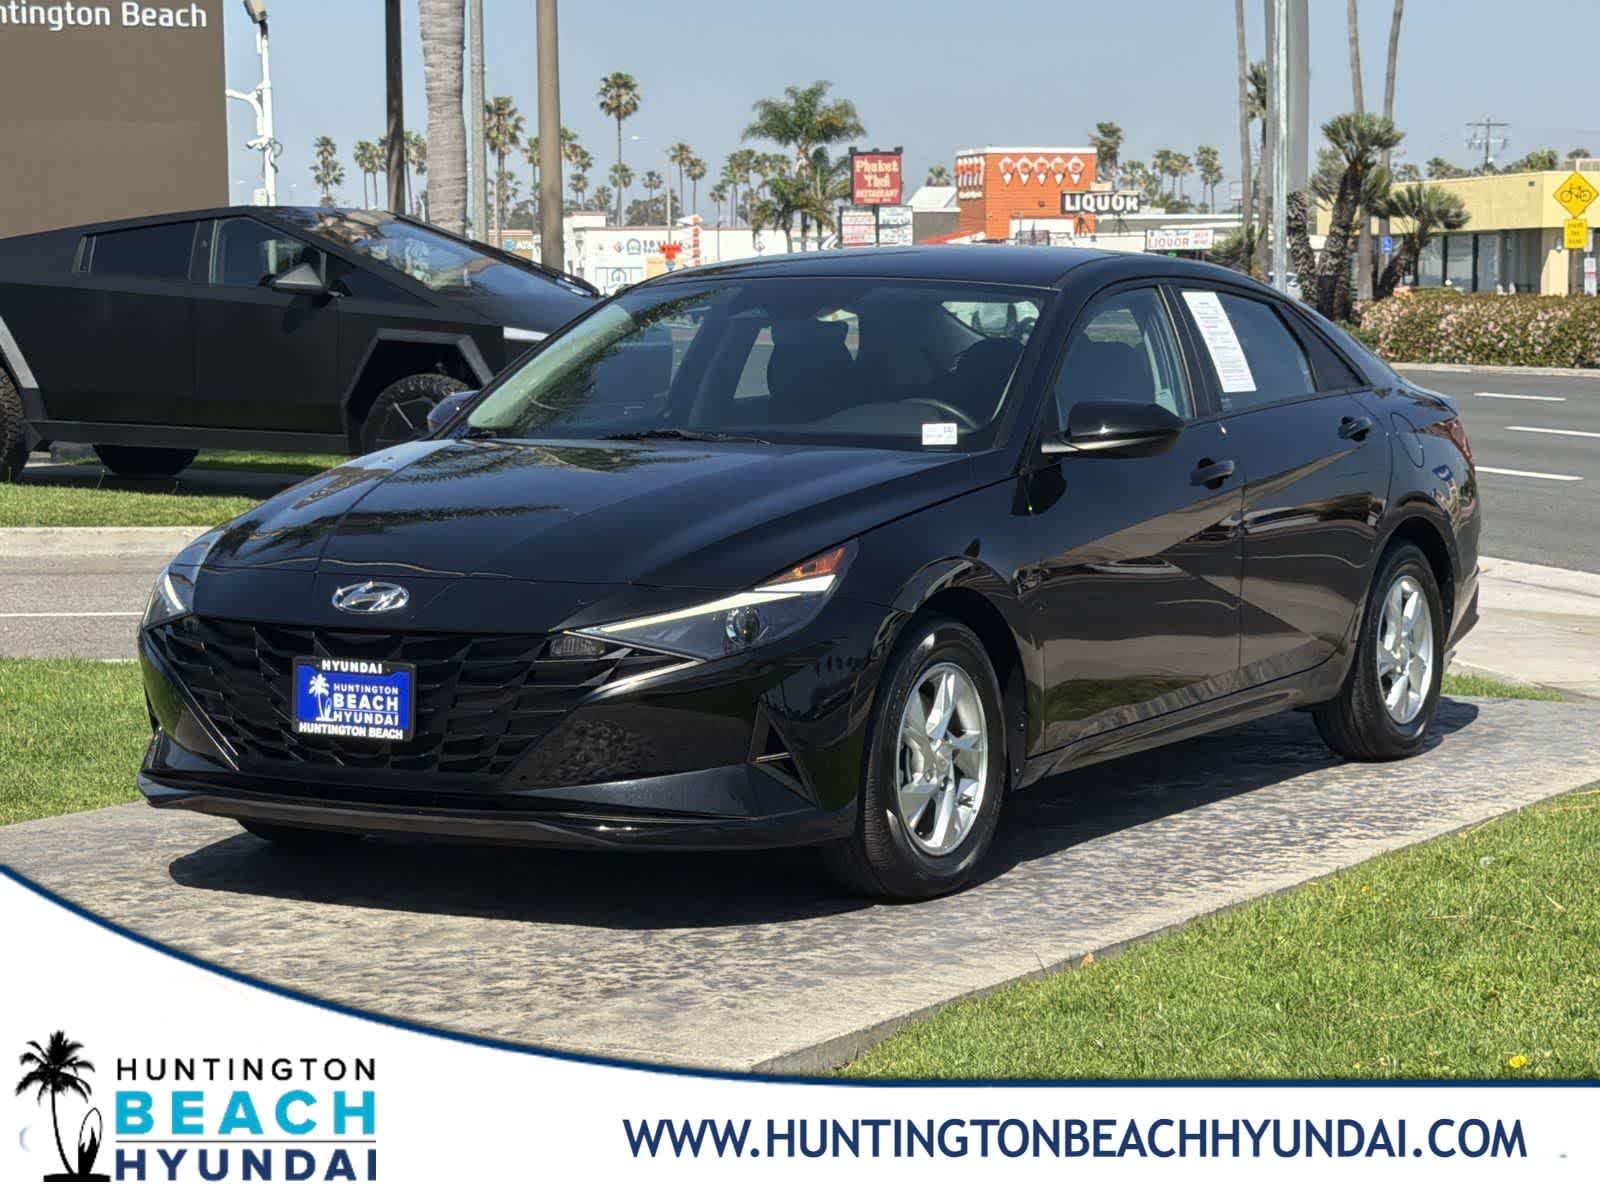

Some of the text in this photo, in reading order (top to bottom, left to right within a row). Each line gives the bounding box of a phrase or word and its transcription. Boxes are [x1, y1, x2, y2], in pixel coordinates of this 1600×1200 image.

[121, 1, 207, 28] Beach
[1064, 193, 1139, 213] LIQUOR
[322, 659, 382, 674] HYUNDAI
[334, 683, 399, 694] HUNTINGTON
[333, 692, 399, 711] BEACH
[334, 710, 399, 726] HYUNDAI
[299, 722, 404, 740] HUNTINGTON BEACH
